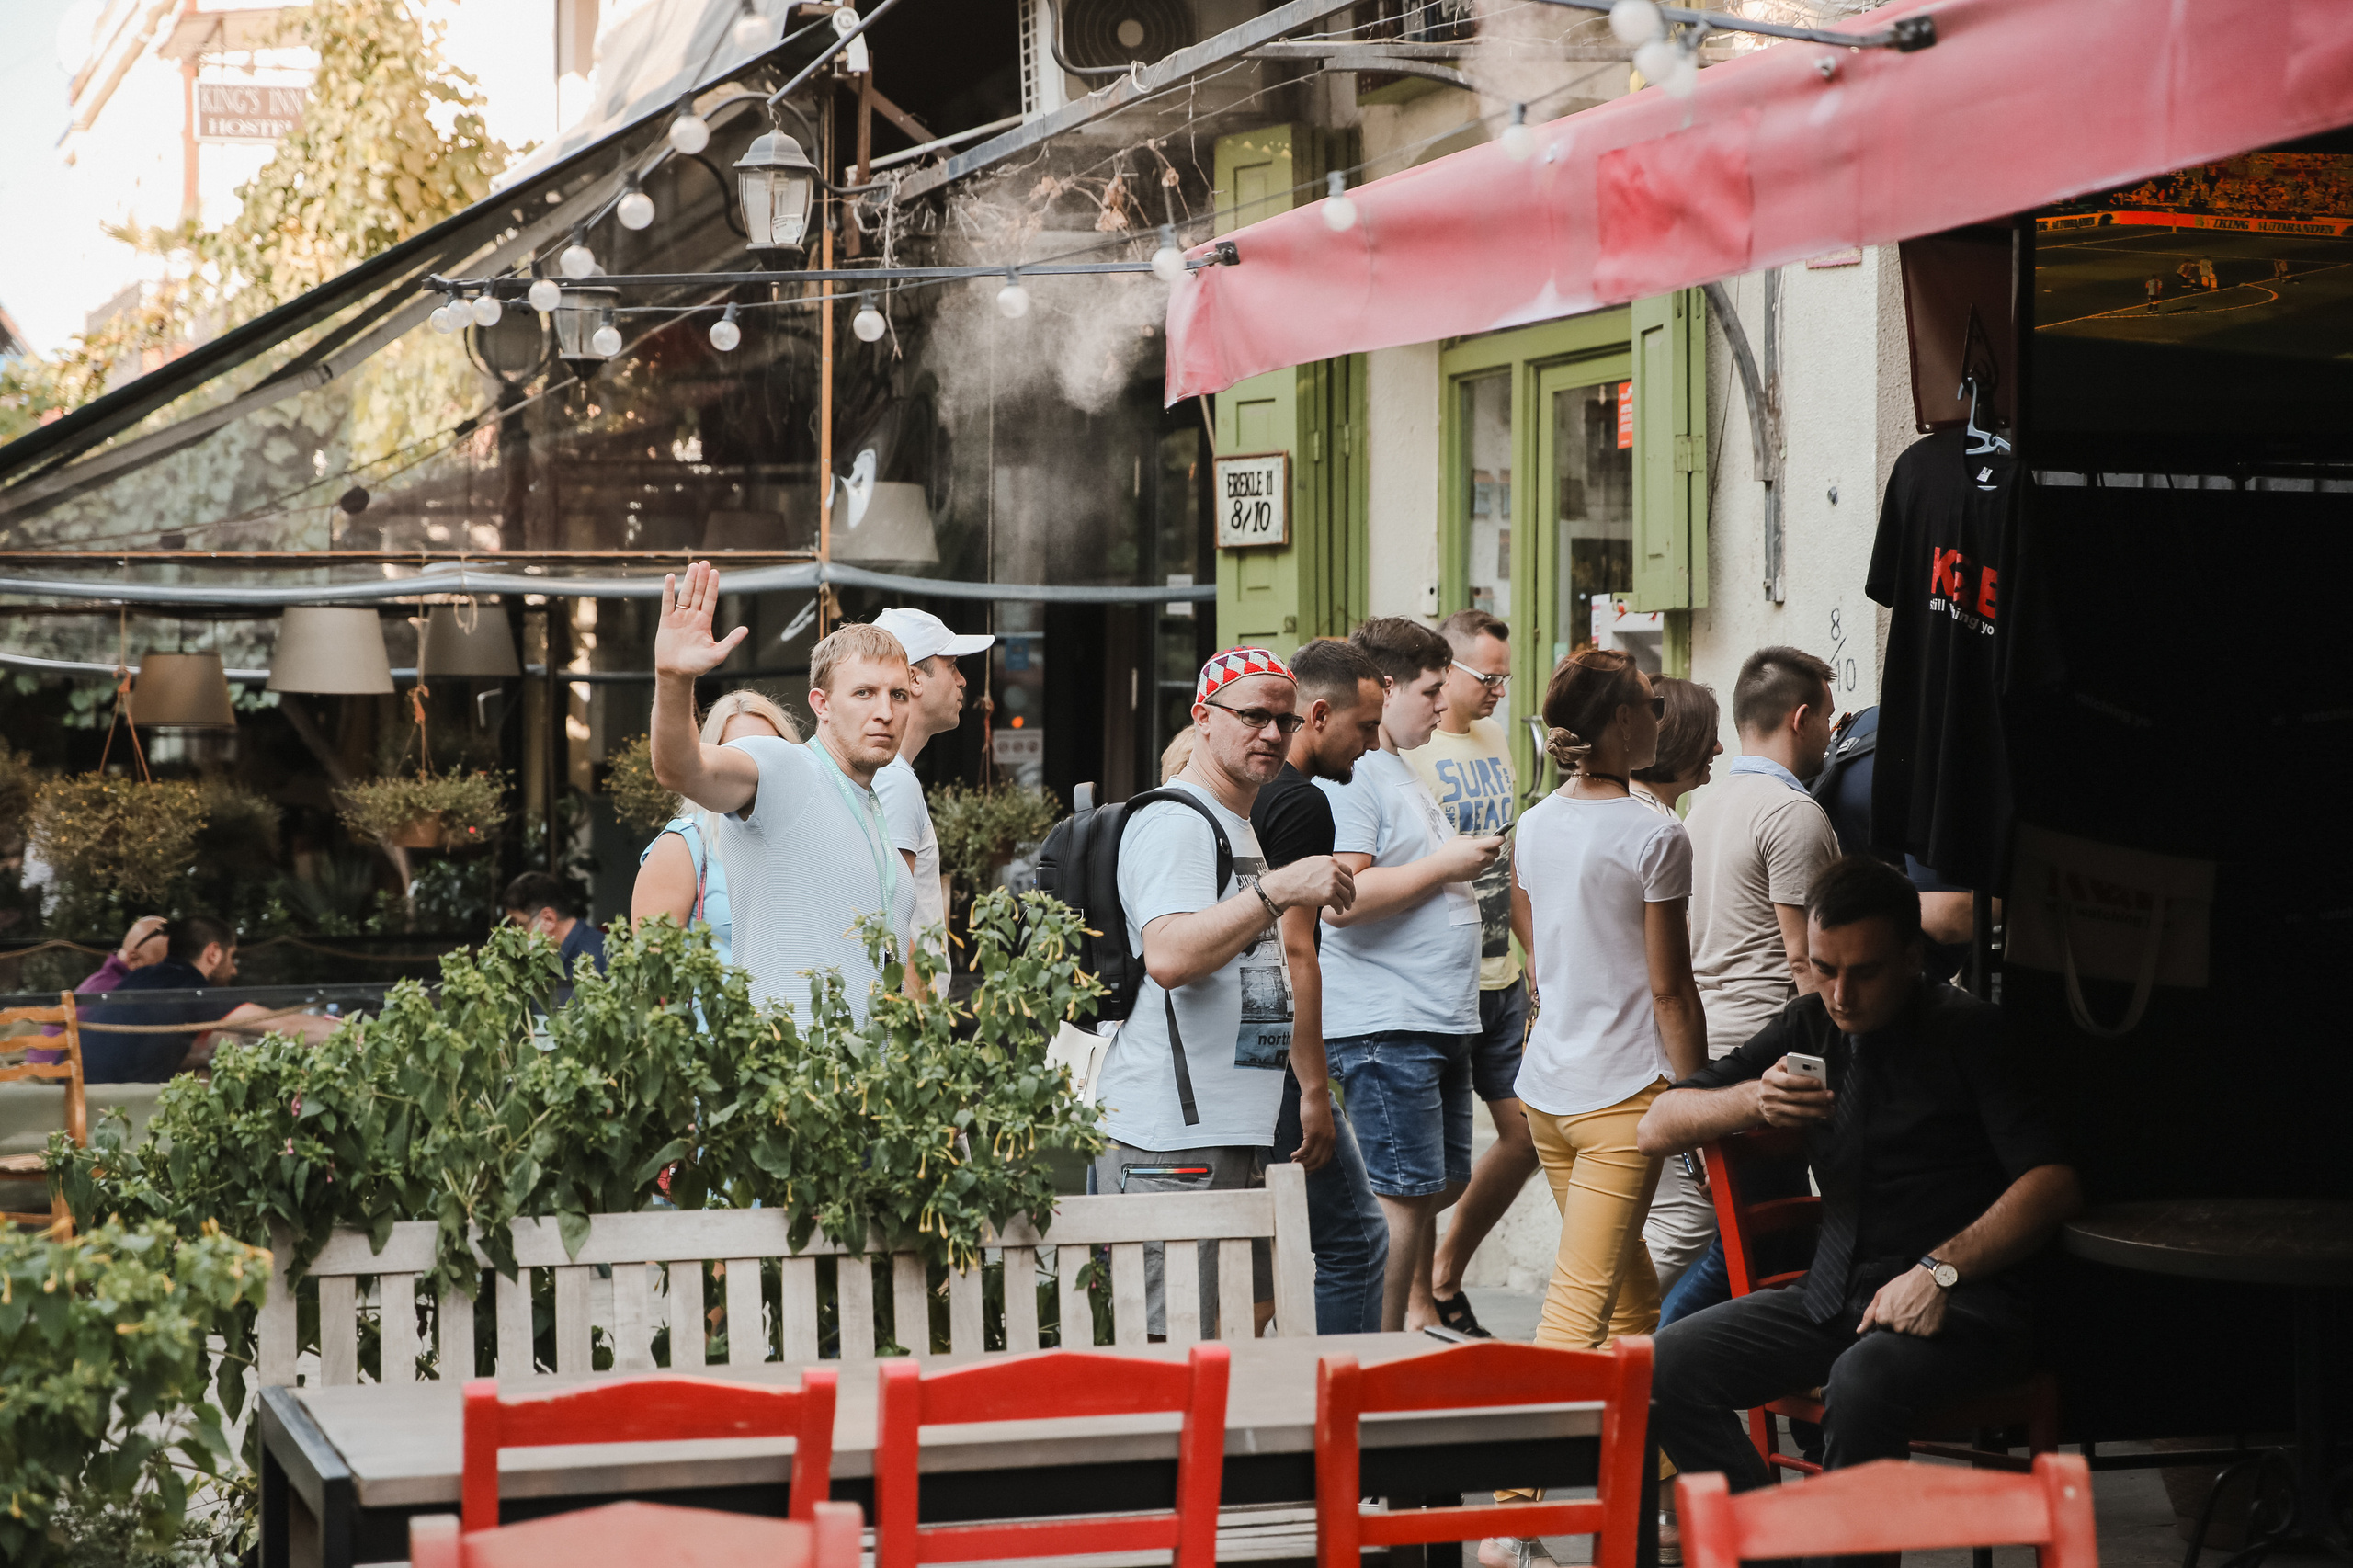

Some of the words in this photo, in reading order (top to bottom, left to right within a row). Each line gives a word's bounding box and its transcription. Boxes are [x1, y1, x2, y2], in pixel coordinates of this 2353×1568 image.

[200, 85, 261, 115] KING'S
[268, 87, 304, 116] INN
[1231, 499, 1271, 533] 8/10
[1435, 757, 1506, 803] SURF
[1258, 1032, 1290, 1046] north
